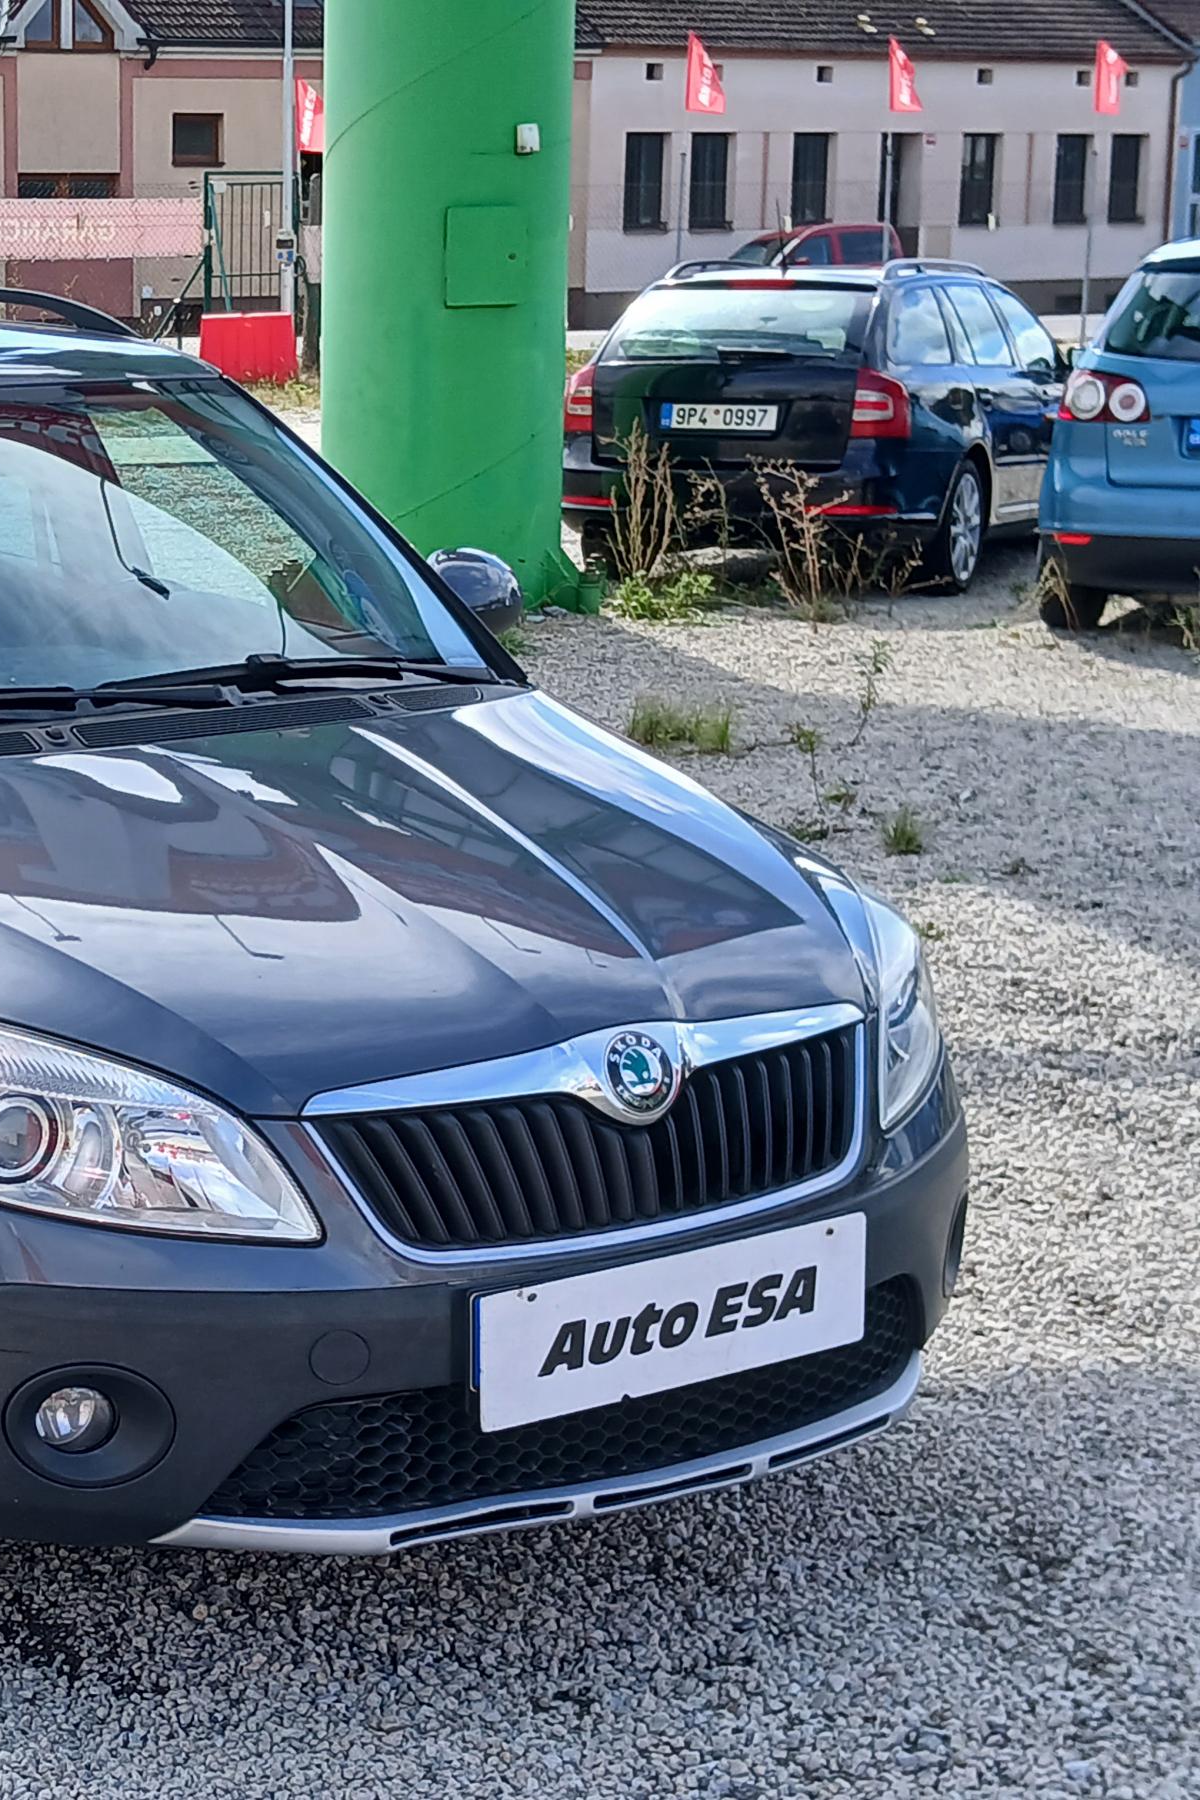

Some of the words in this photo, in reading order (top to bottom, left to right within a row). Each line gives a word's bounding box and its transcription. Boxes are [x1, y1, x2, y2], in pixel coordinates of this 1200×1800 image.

[675, 407, 708, 426] 9P4
[722, 408, 768, 427] 0997
[538, 1301, 700, 1378] Auto
[704, 1264, 818, 1338] ESA
